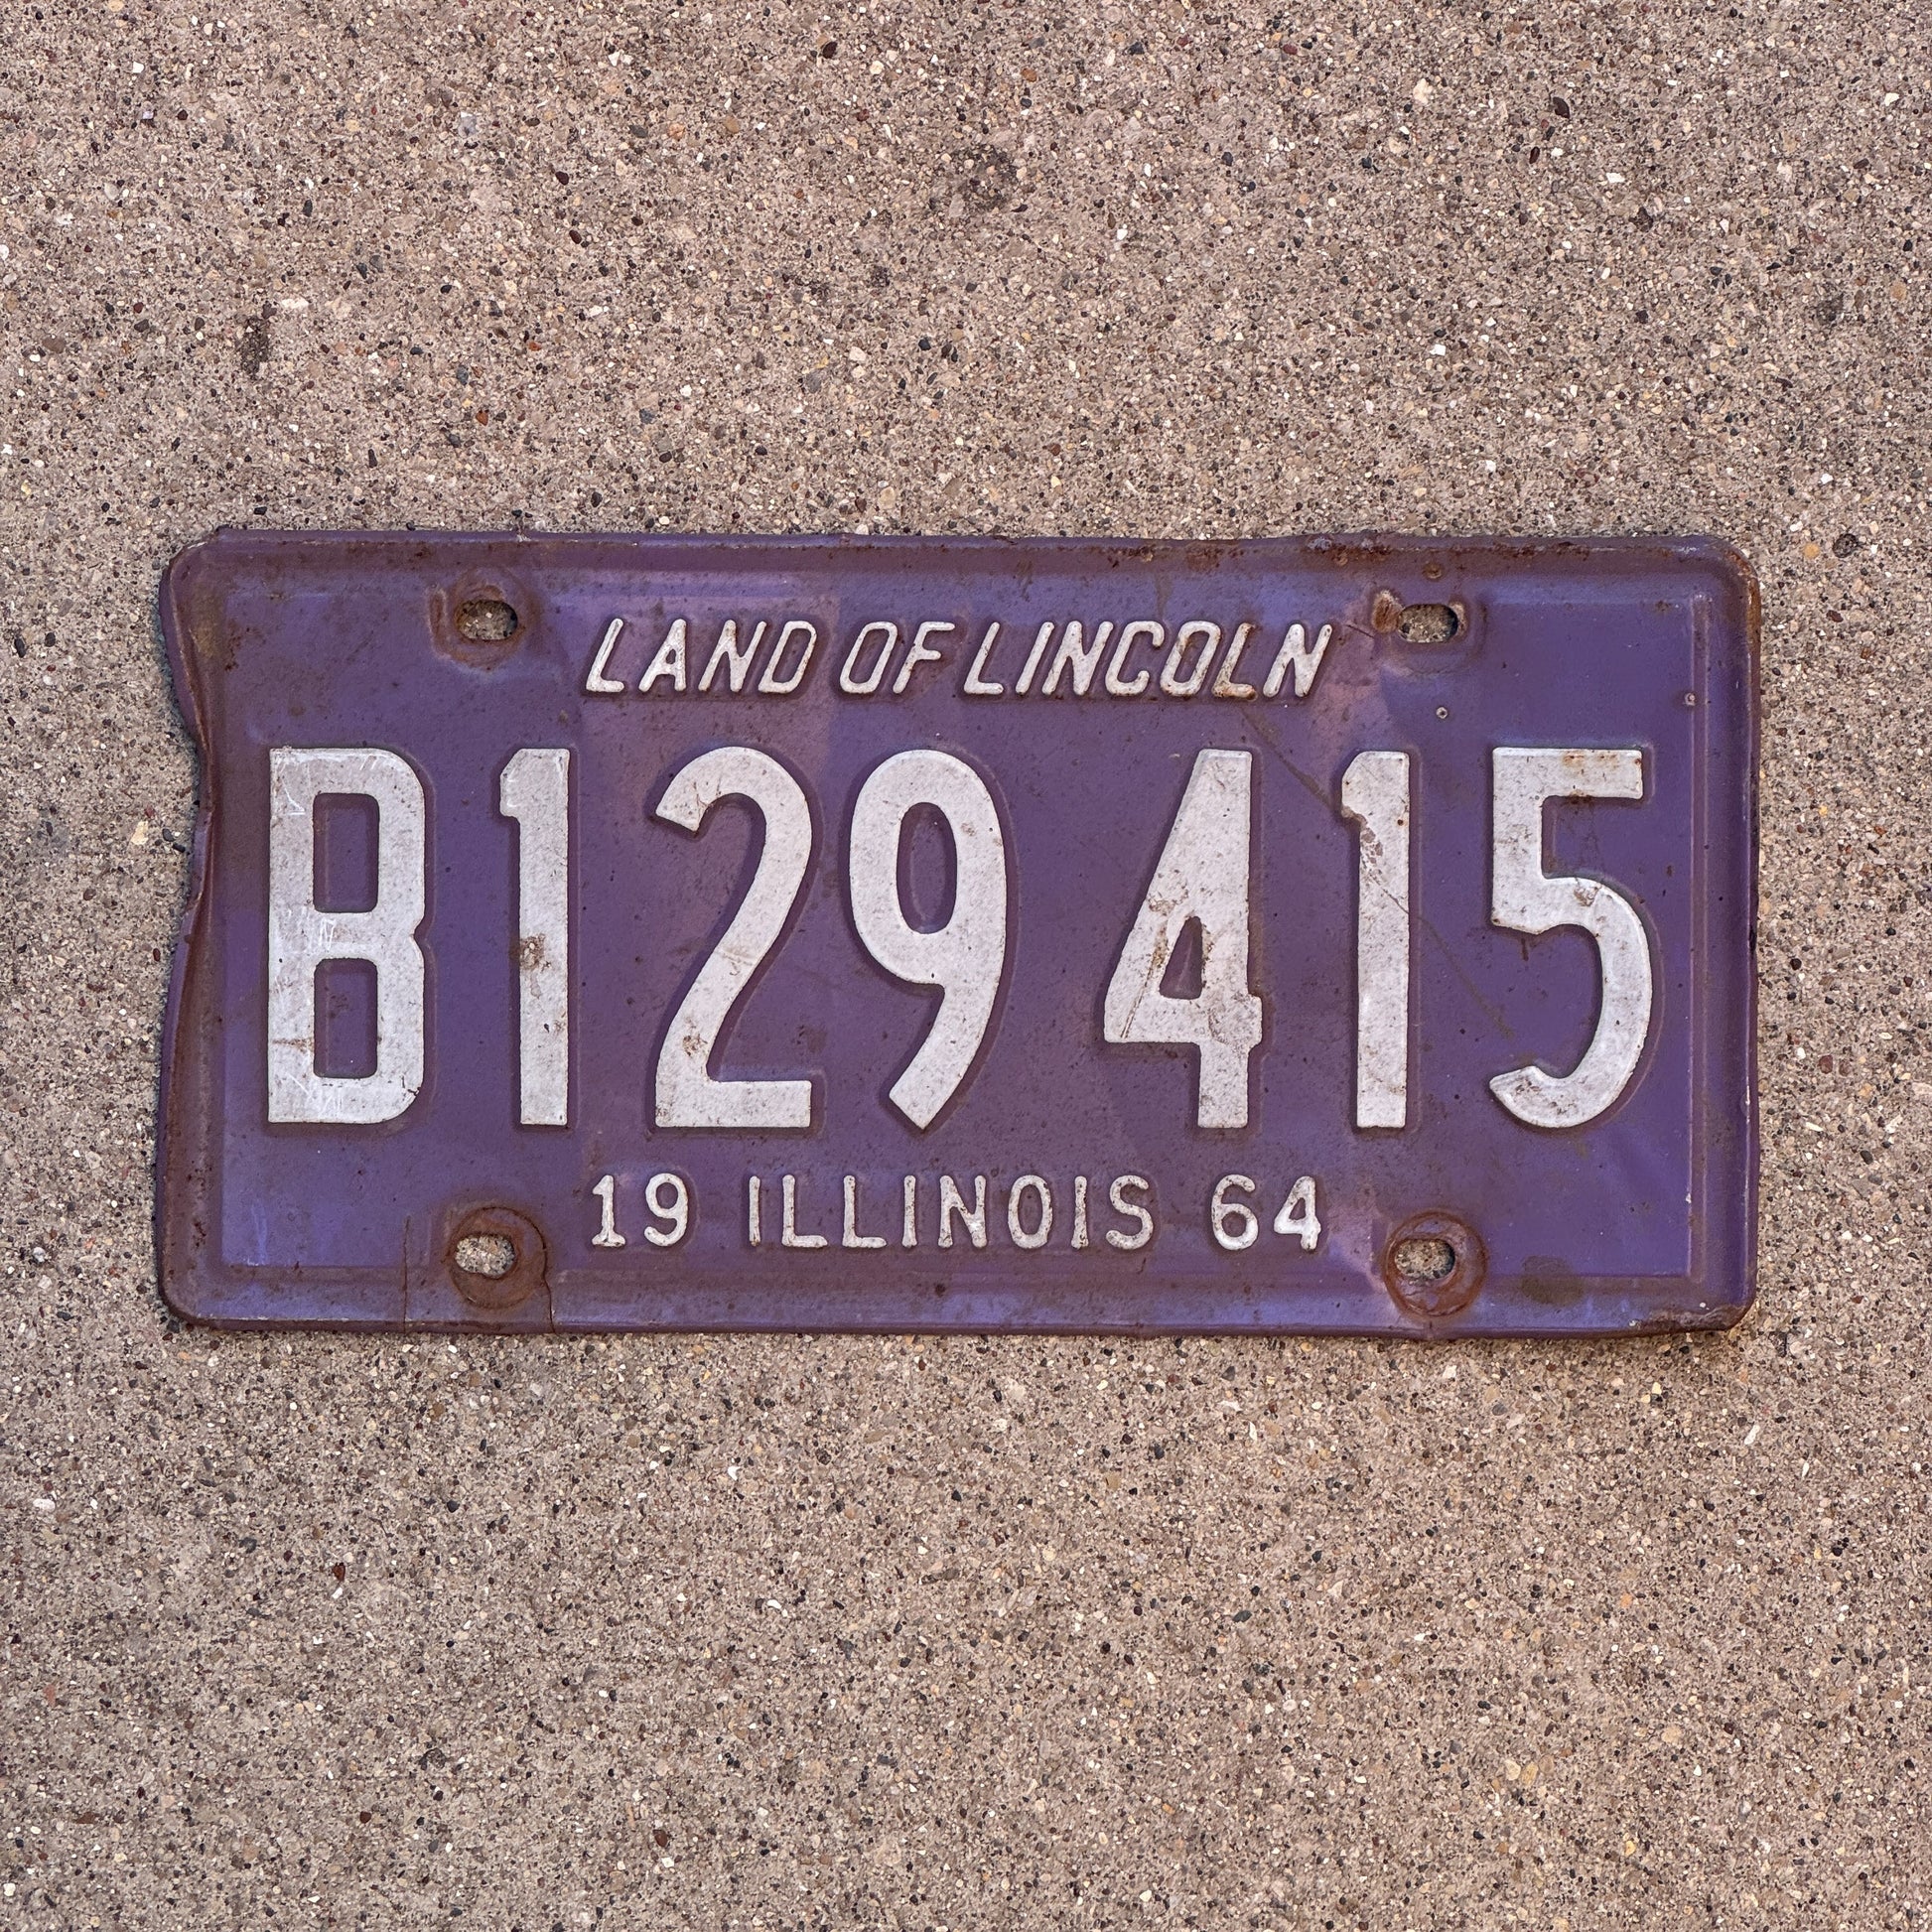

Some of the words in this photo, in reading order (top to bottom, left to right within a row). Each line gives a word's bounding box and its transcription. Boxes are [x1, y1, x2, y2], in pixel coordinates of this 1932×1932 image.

[585, 618, 817, 694] LAND
[839, 620, 957, 695] OF
[963, 621, 1333, 698] LINCOLN
[591, 1173, 689, 1248] 19
[748, 1173, 1154, 1251] ILLINOIS
[1209, 1173, 1322, 1251] 64
